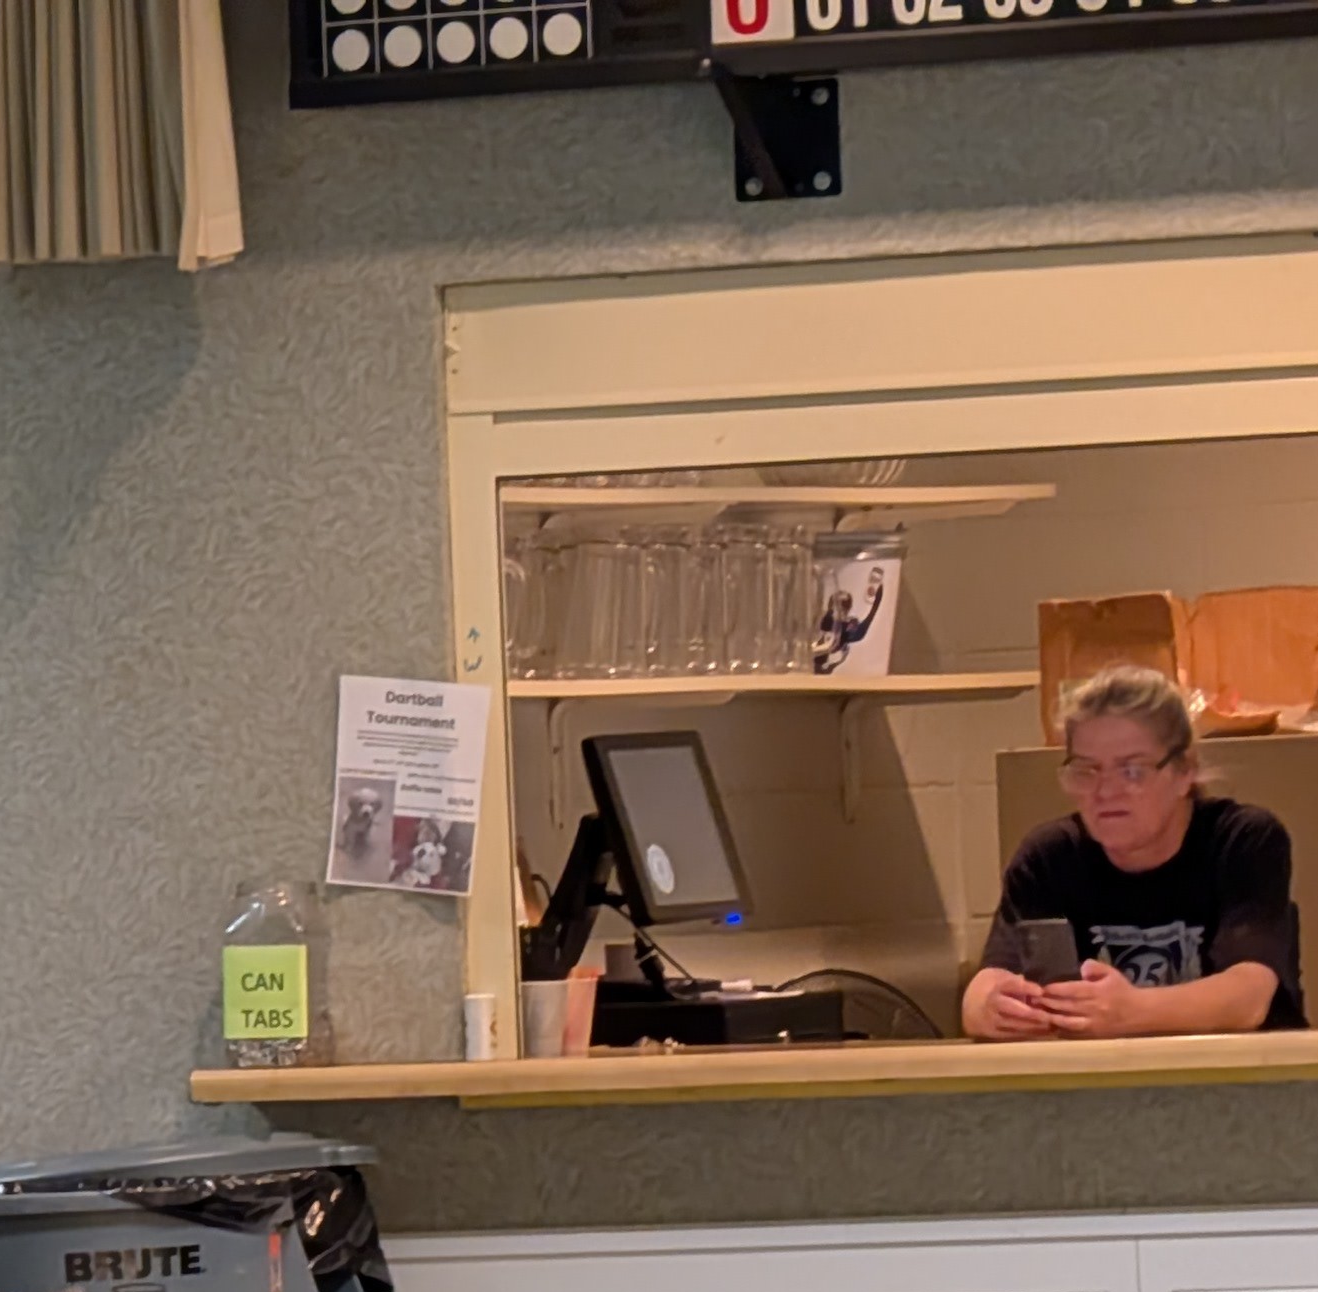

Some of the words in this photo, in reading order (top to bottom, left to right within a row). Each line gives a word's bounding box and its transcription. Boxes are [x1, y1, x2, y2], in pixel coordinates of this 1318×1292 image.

[385, 690, 444, 707] Dartball
[366, 710, 456, 730] Tournament
[241, 973, 285, 992] CAN
[241, 1009, 294, 1029] TABS
[65, 1244, 201, 1283] BRUTE
